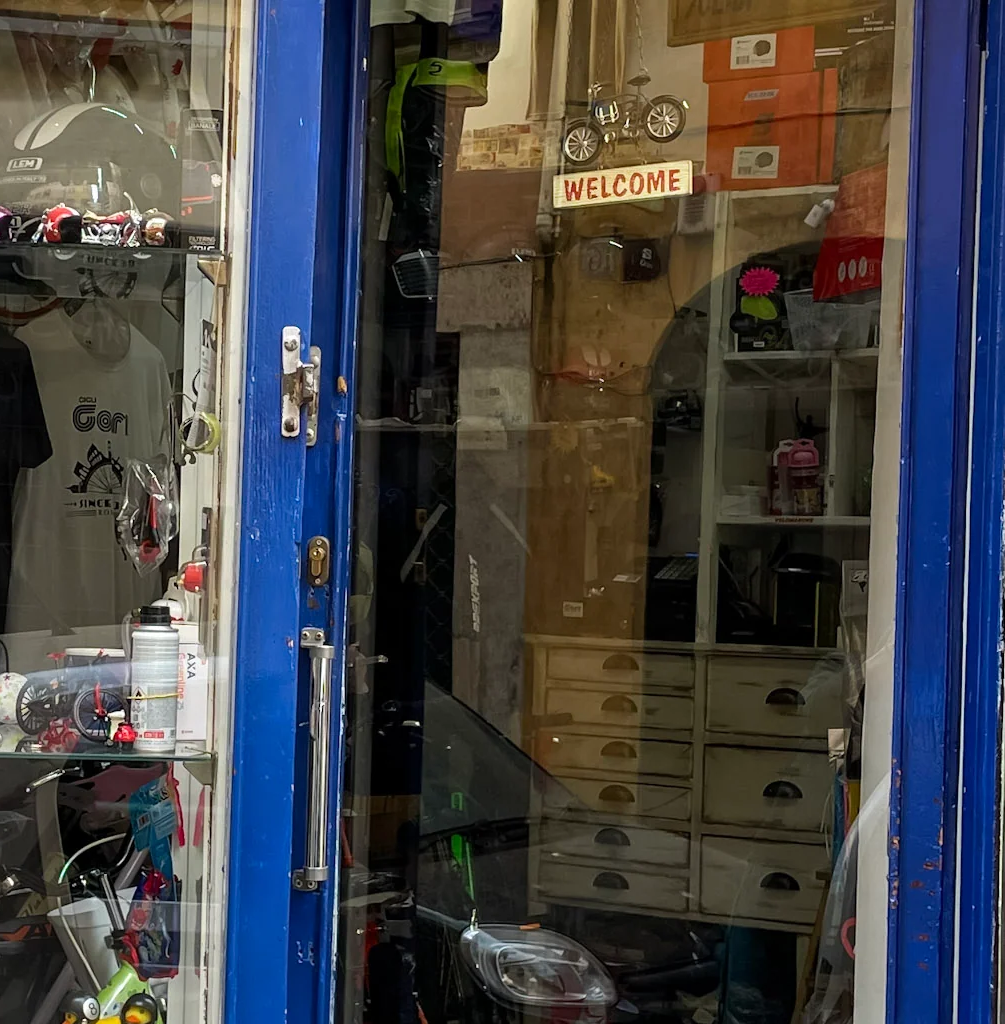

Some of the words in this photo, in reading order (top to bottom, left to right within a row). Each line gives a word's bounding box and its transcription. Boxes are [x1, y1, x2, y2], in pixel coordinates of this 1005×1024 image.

[12, 159, 35, 169] LEM
[564, 169, 681, 202] WELCOME
[78, 499, 112, 509] SINCE
[187, 652, 196, 679] AXA
[89, 1002, 97, 1016] 8
